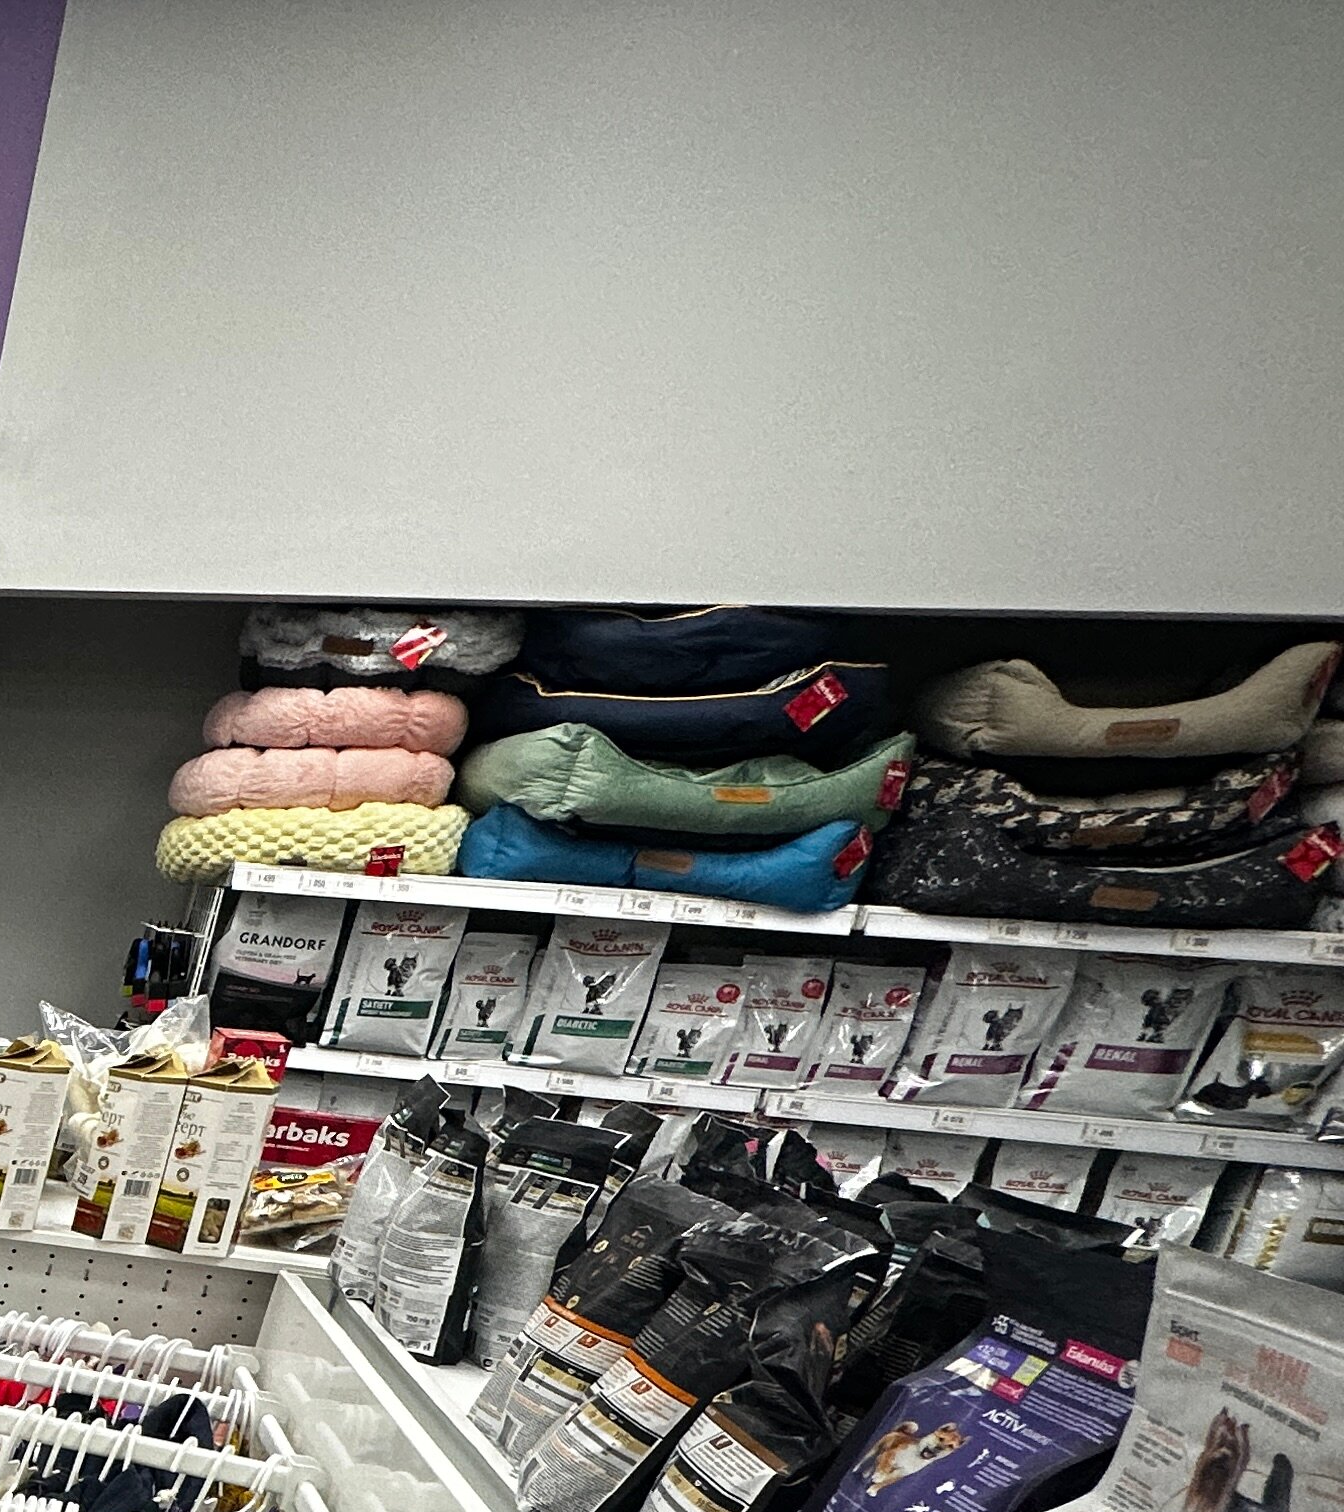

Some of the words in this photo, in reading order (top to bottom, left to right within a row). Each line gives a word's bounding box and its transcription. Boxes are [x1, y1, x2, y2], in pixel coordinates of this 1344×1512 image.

[370, 921, 406, 933] ROYAL
[407, 923, 444, 935] CANIN
[239, 931, 327, 951] GRANDORF
[568, 939, 602, 951] ROYAL
[361, 1000, 394, 1011] SATIETY
[1248, 1006, 1303, 1021] OYAL
[555, 1019, 598, 1031] DIABETIC
[1095, 1047, 1137, 1064] RENAL
[1066, 1345, 1117, 1375] Eukanuba
[981, 1408, 1025, 1433] ACTIV
